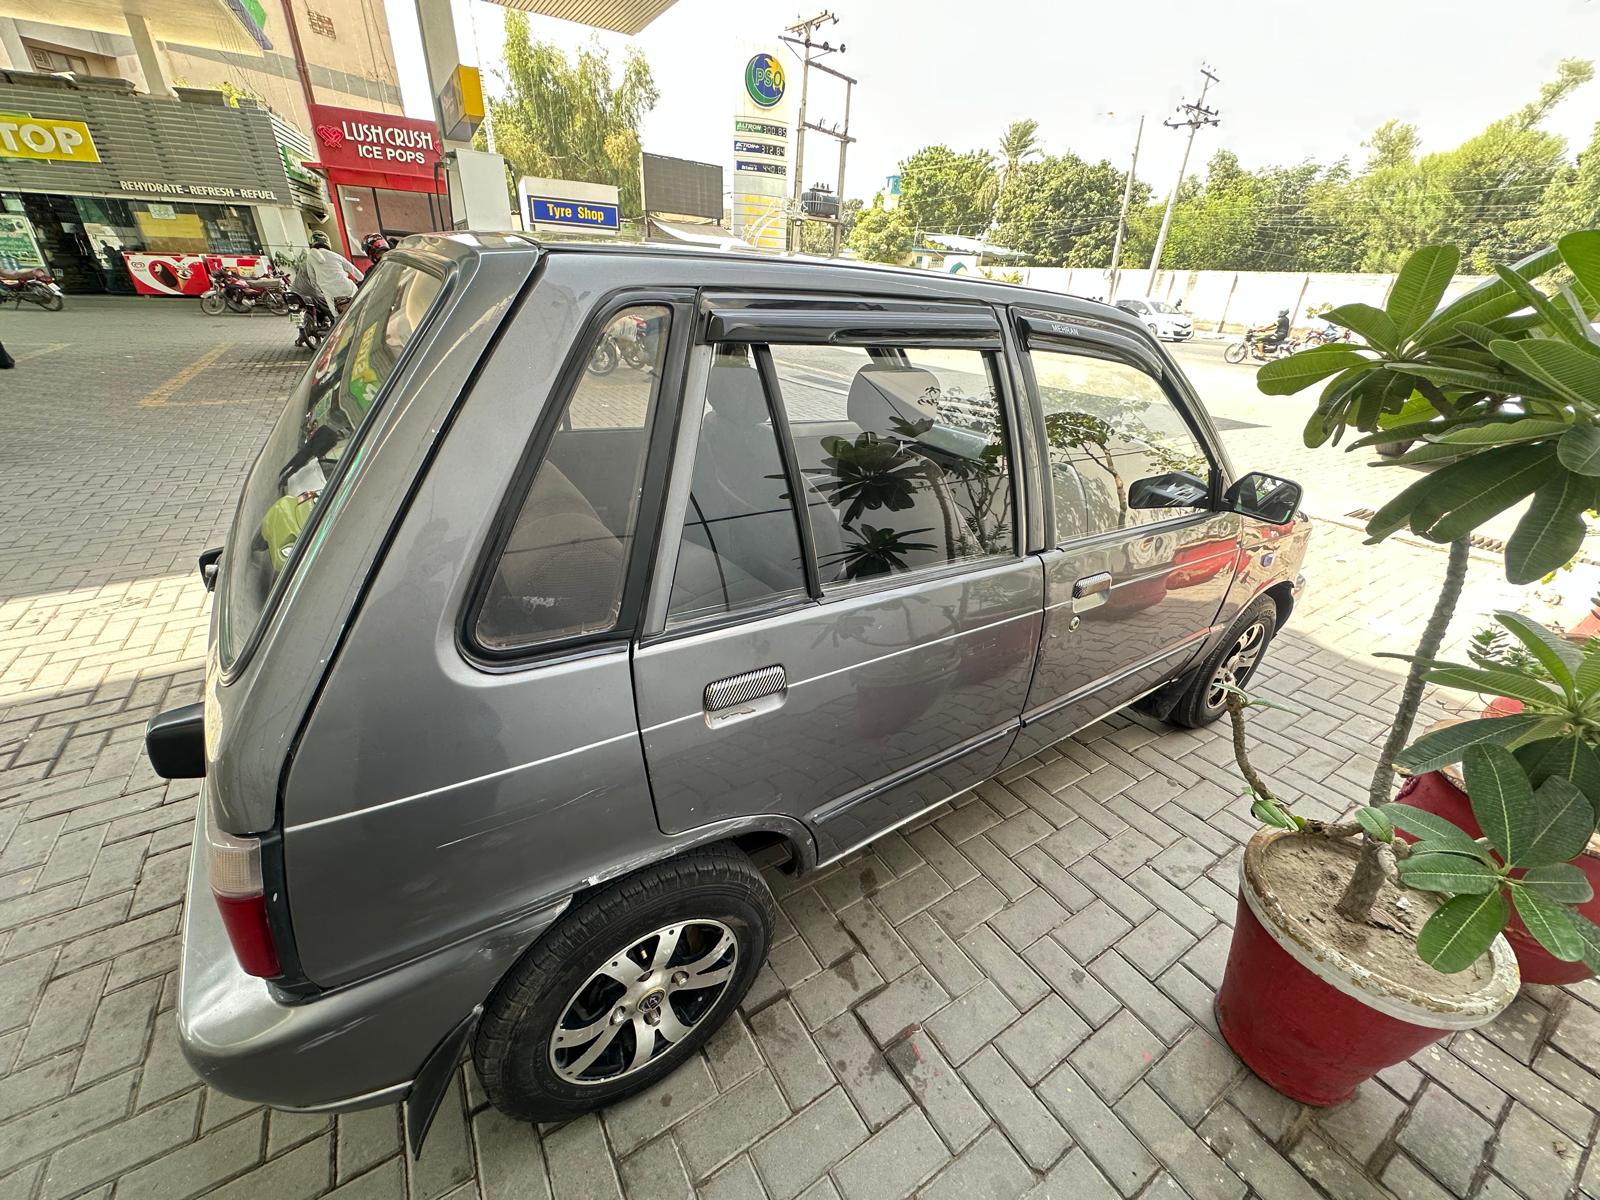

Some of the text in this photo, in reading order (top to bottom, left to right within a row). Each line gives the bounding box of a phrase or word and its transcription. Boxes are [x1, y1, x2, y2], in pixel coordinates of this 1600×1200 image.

[755, 67, 782, 88] PSO
[342, 121, 433, 150] LUSH CRUSH
[358, 144, 425, 164] ICE POPS
[547, 203, 604, 222] Tyre Shop
[1051, 323, 1079, 335] MEHRAN
